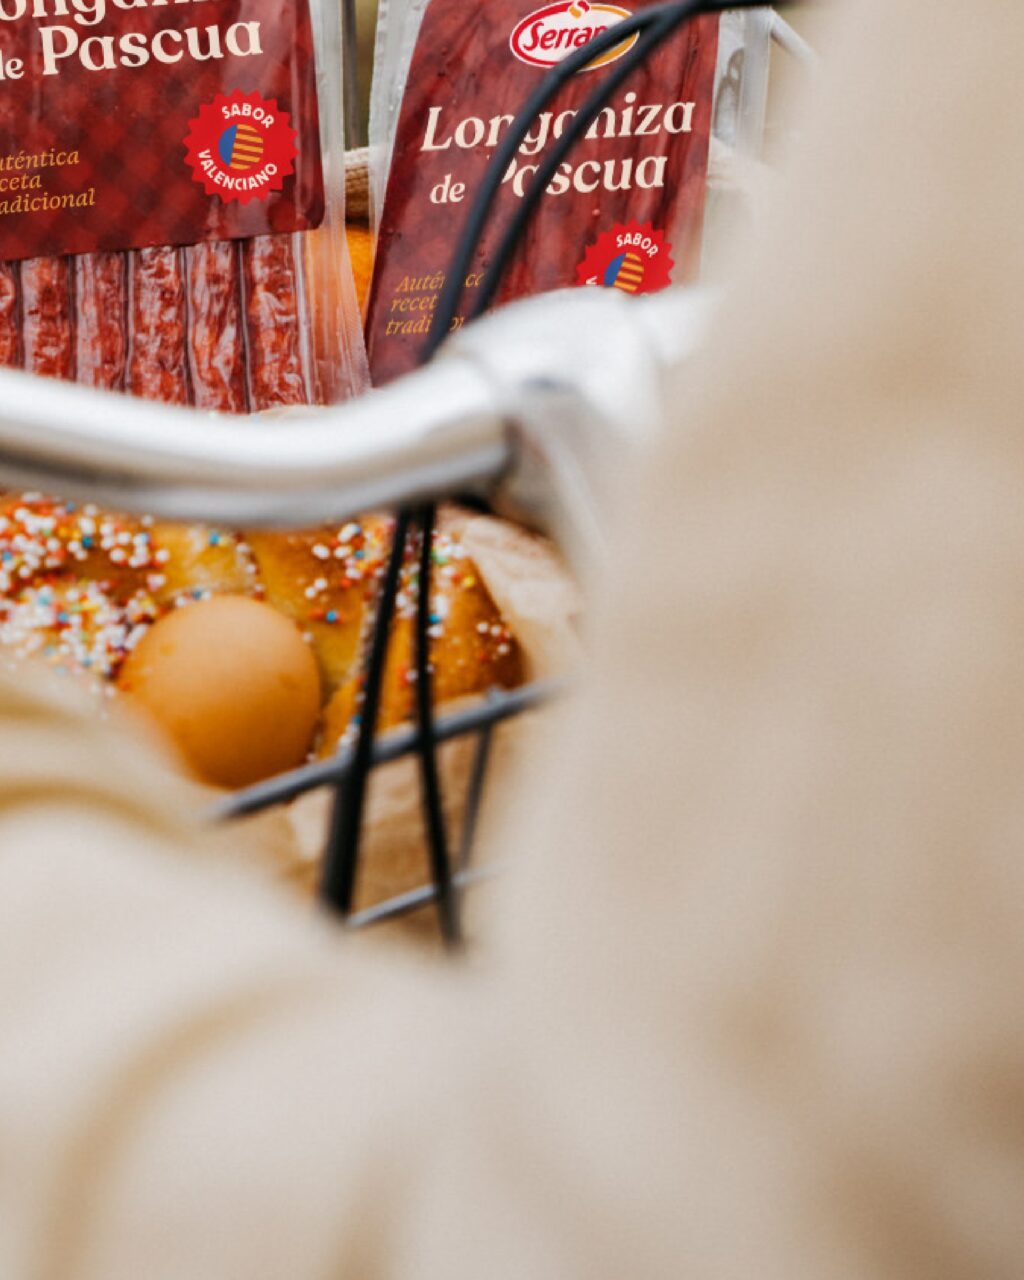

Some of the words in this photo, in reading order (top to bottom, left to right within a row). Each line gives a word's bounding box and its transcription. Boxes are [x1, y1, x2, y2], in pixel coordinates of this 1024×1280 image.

[38, 20, 264, 75] Pascua
[523, 21, 608, 52] Serra
[221, 102, 275, 128] SABOR
[198, 148, 278, 191] VALENCIANO
[429, 173, 466, 204] de
[486, 154, 668, 198] scua
[616, 232, 659, 258] SABOR
[390, 293, 438, 312] recet
